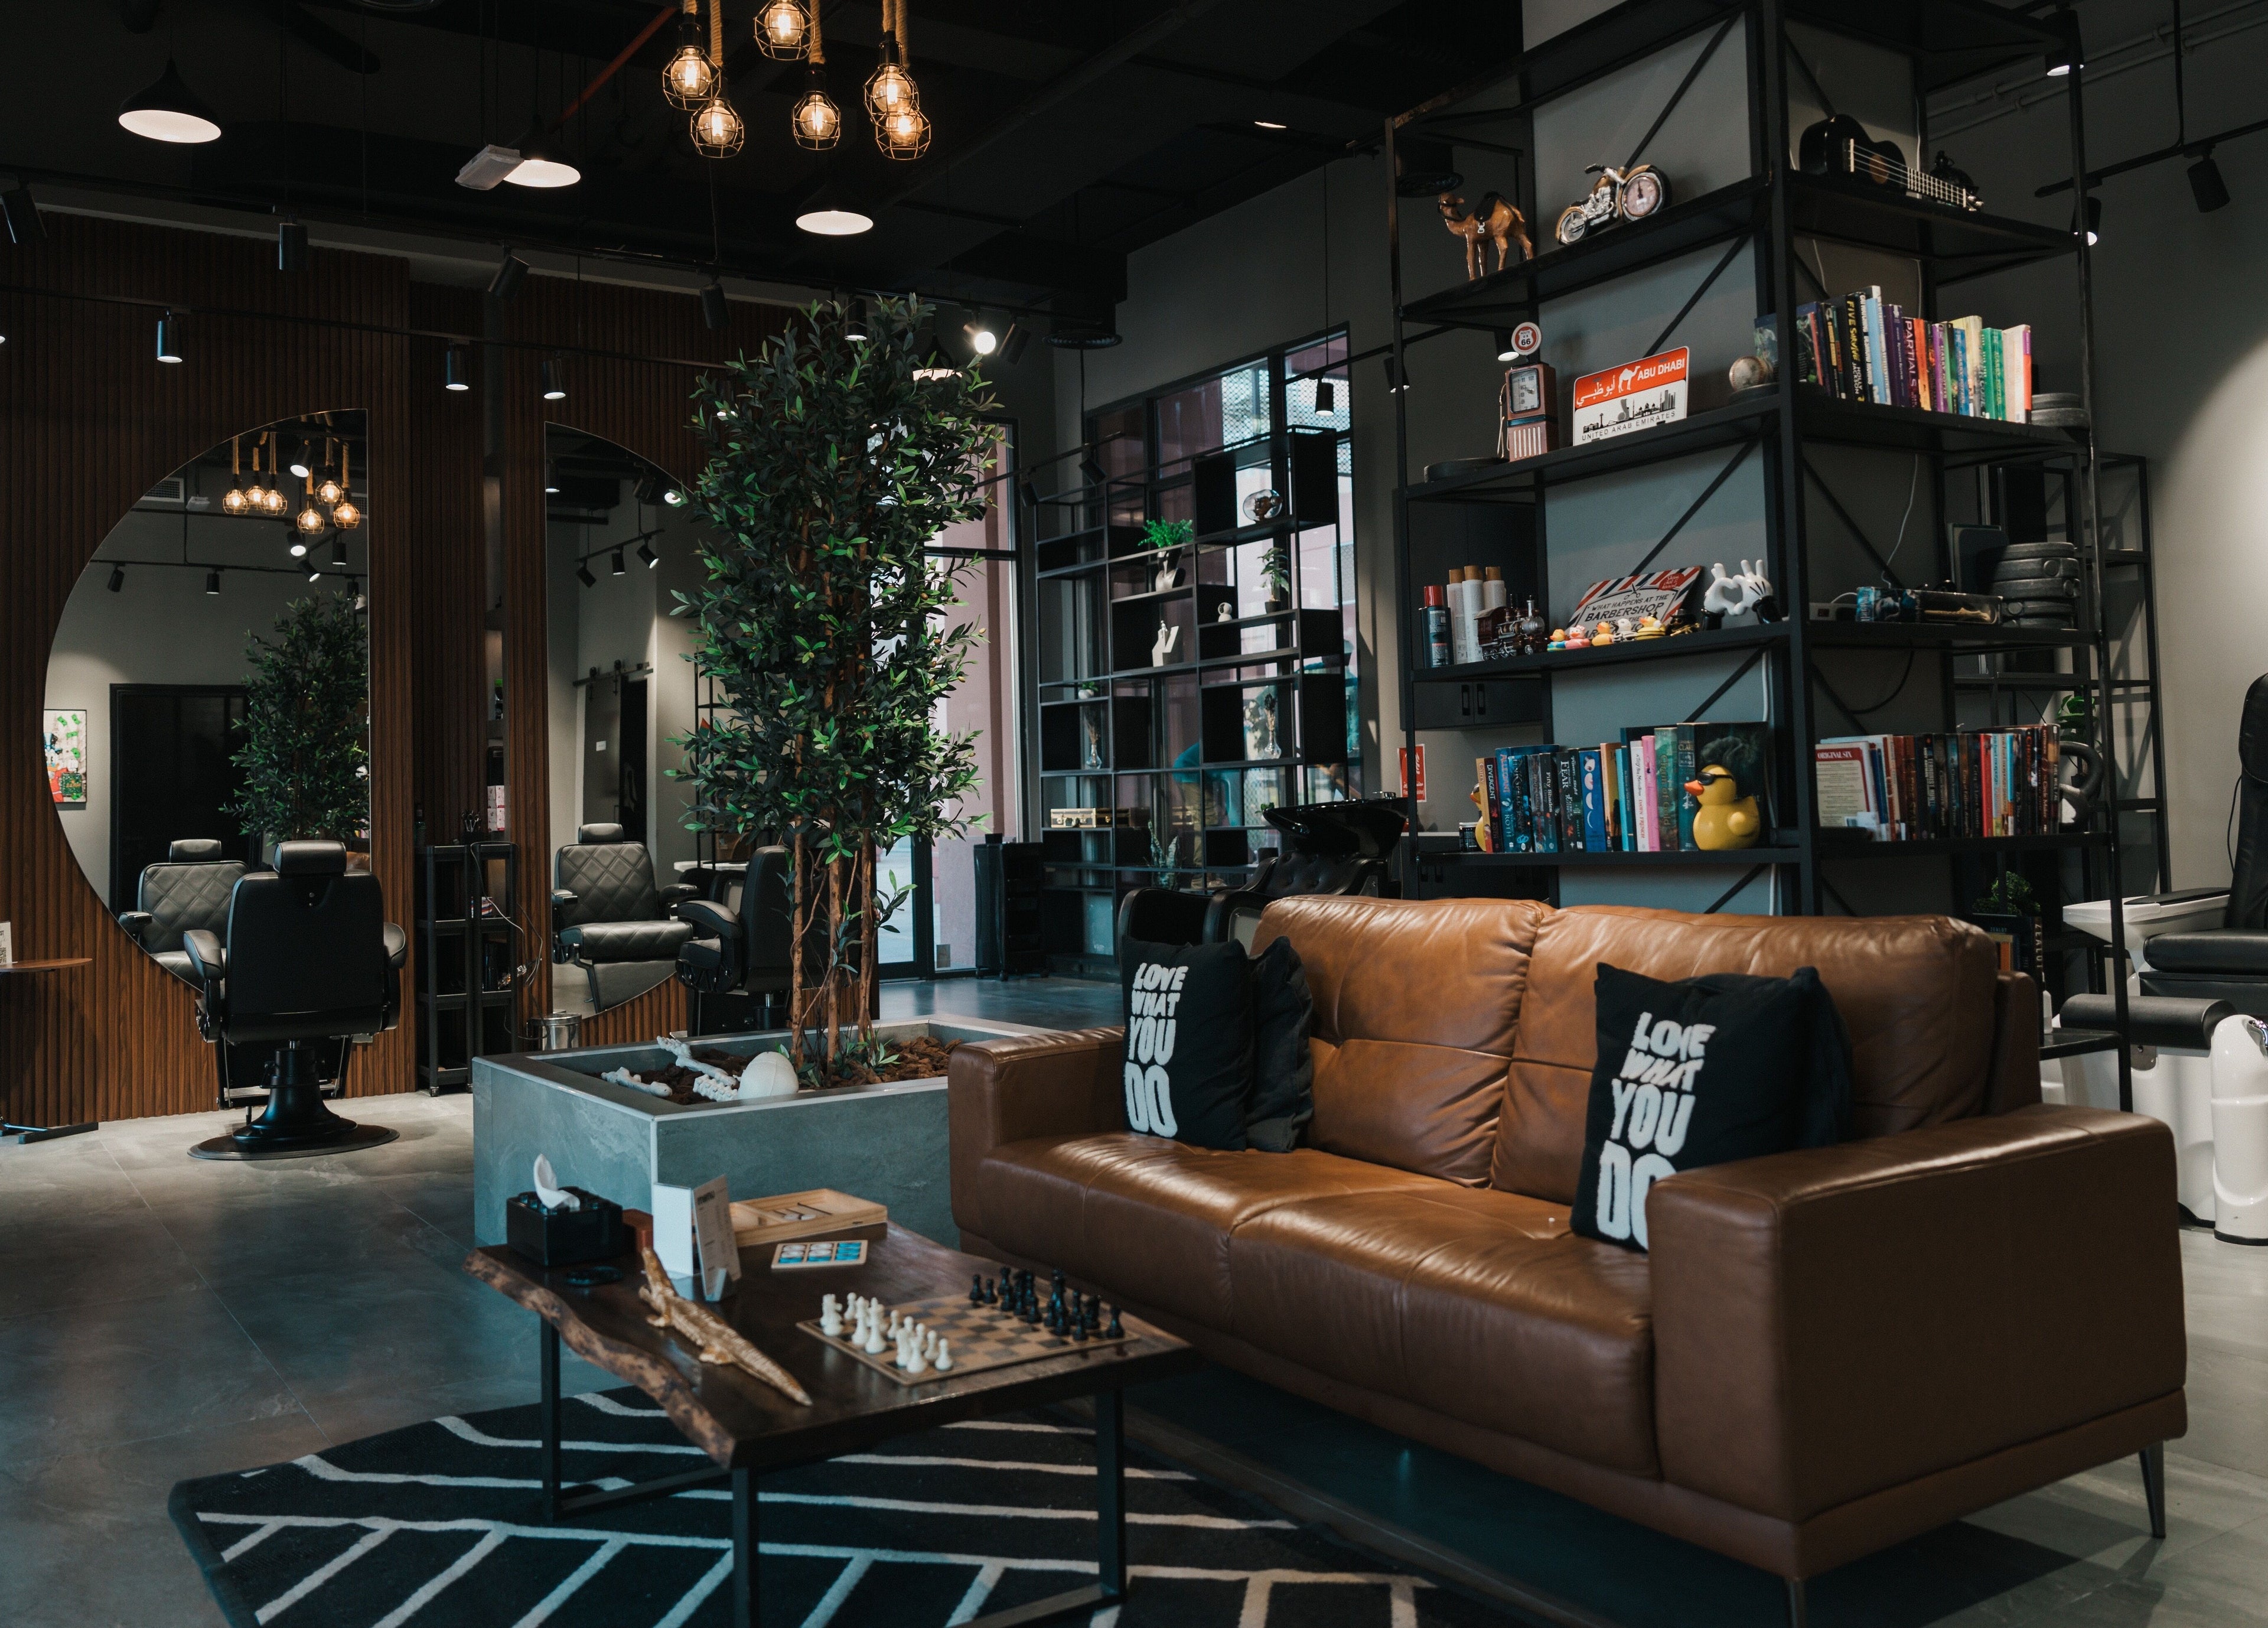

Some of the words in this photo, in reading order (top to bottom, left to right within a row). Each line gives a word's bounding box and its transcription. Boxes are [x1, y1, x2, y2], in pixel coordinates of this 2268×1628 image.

[1846, 300, 1857, 326] FIVE
[1905, 321, 1917, 386] PARTIALS
[1637, 366, 1656, 381] ABU
[1657, 358, 1685, 375] DHABI
[1582, 429, 1608, 441] UNITED
[1612, 422, 1632, 432] ARAB
[1636, 411, 1675, 426] EMIRATES
[1585, 603, 1664, 622] BARBERSHOP
[1592, 603, 1611, 611] WHAT
[1612, 598, 1643, 608] HAPPENS
[1487, 764, 1495, 800] DIVERGENT
[1560, 761, 1570, 789] FEAR
[1662, 788, 1669, 799] of
[1662, 802, 1670, 825] Gold
[2035, 924, 2043, 968] ZEALOT
[1133, 962, 1188, 991] LOVE
[1131, 989, 1181, 1017] WHAT
[1129, 1016, 1176, 1065] YOU
[1630, 1011, 1717, 1061] LOVE
[1619, 1047, 1704, 1091] WHAT
[1125, 1062, 1178, 1138] DO
[1610, 1078, 1696, 1157] YOU
